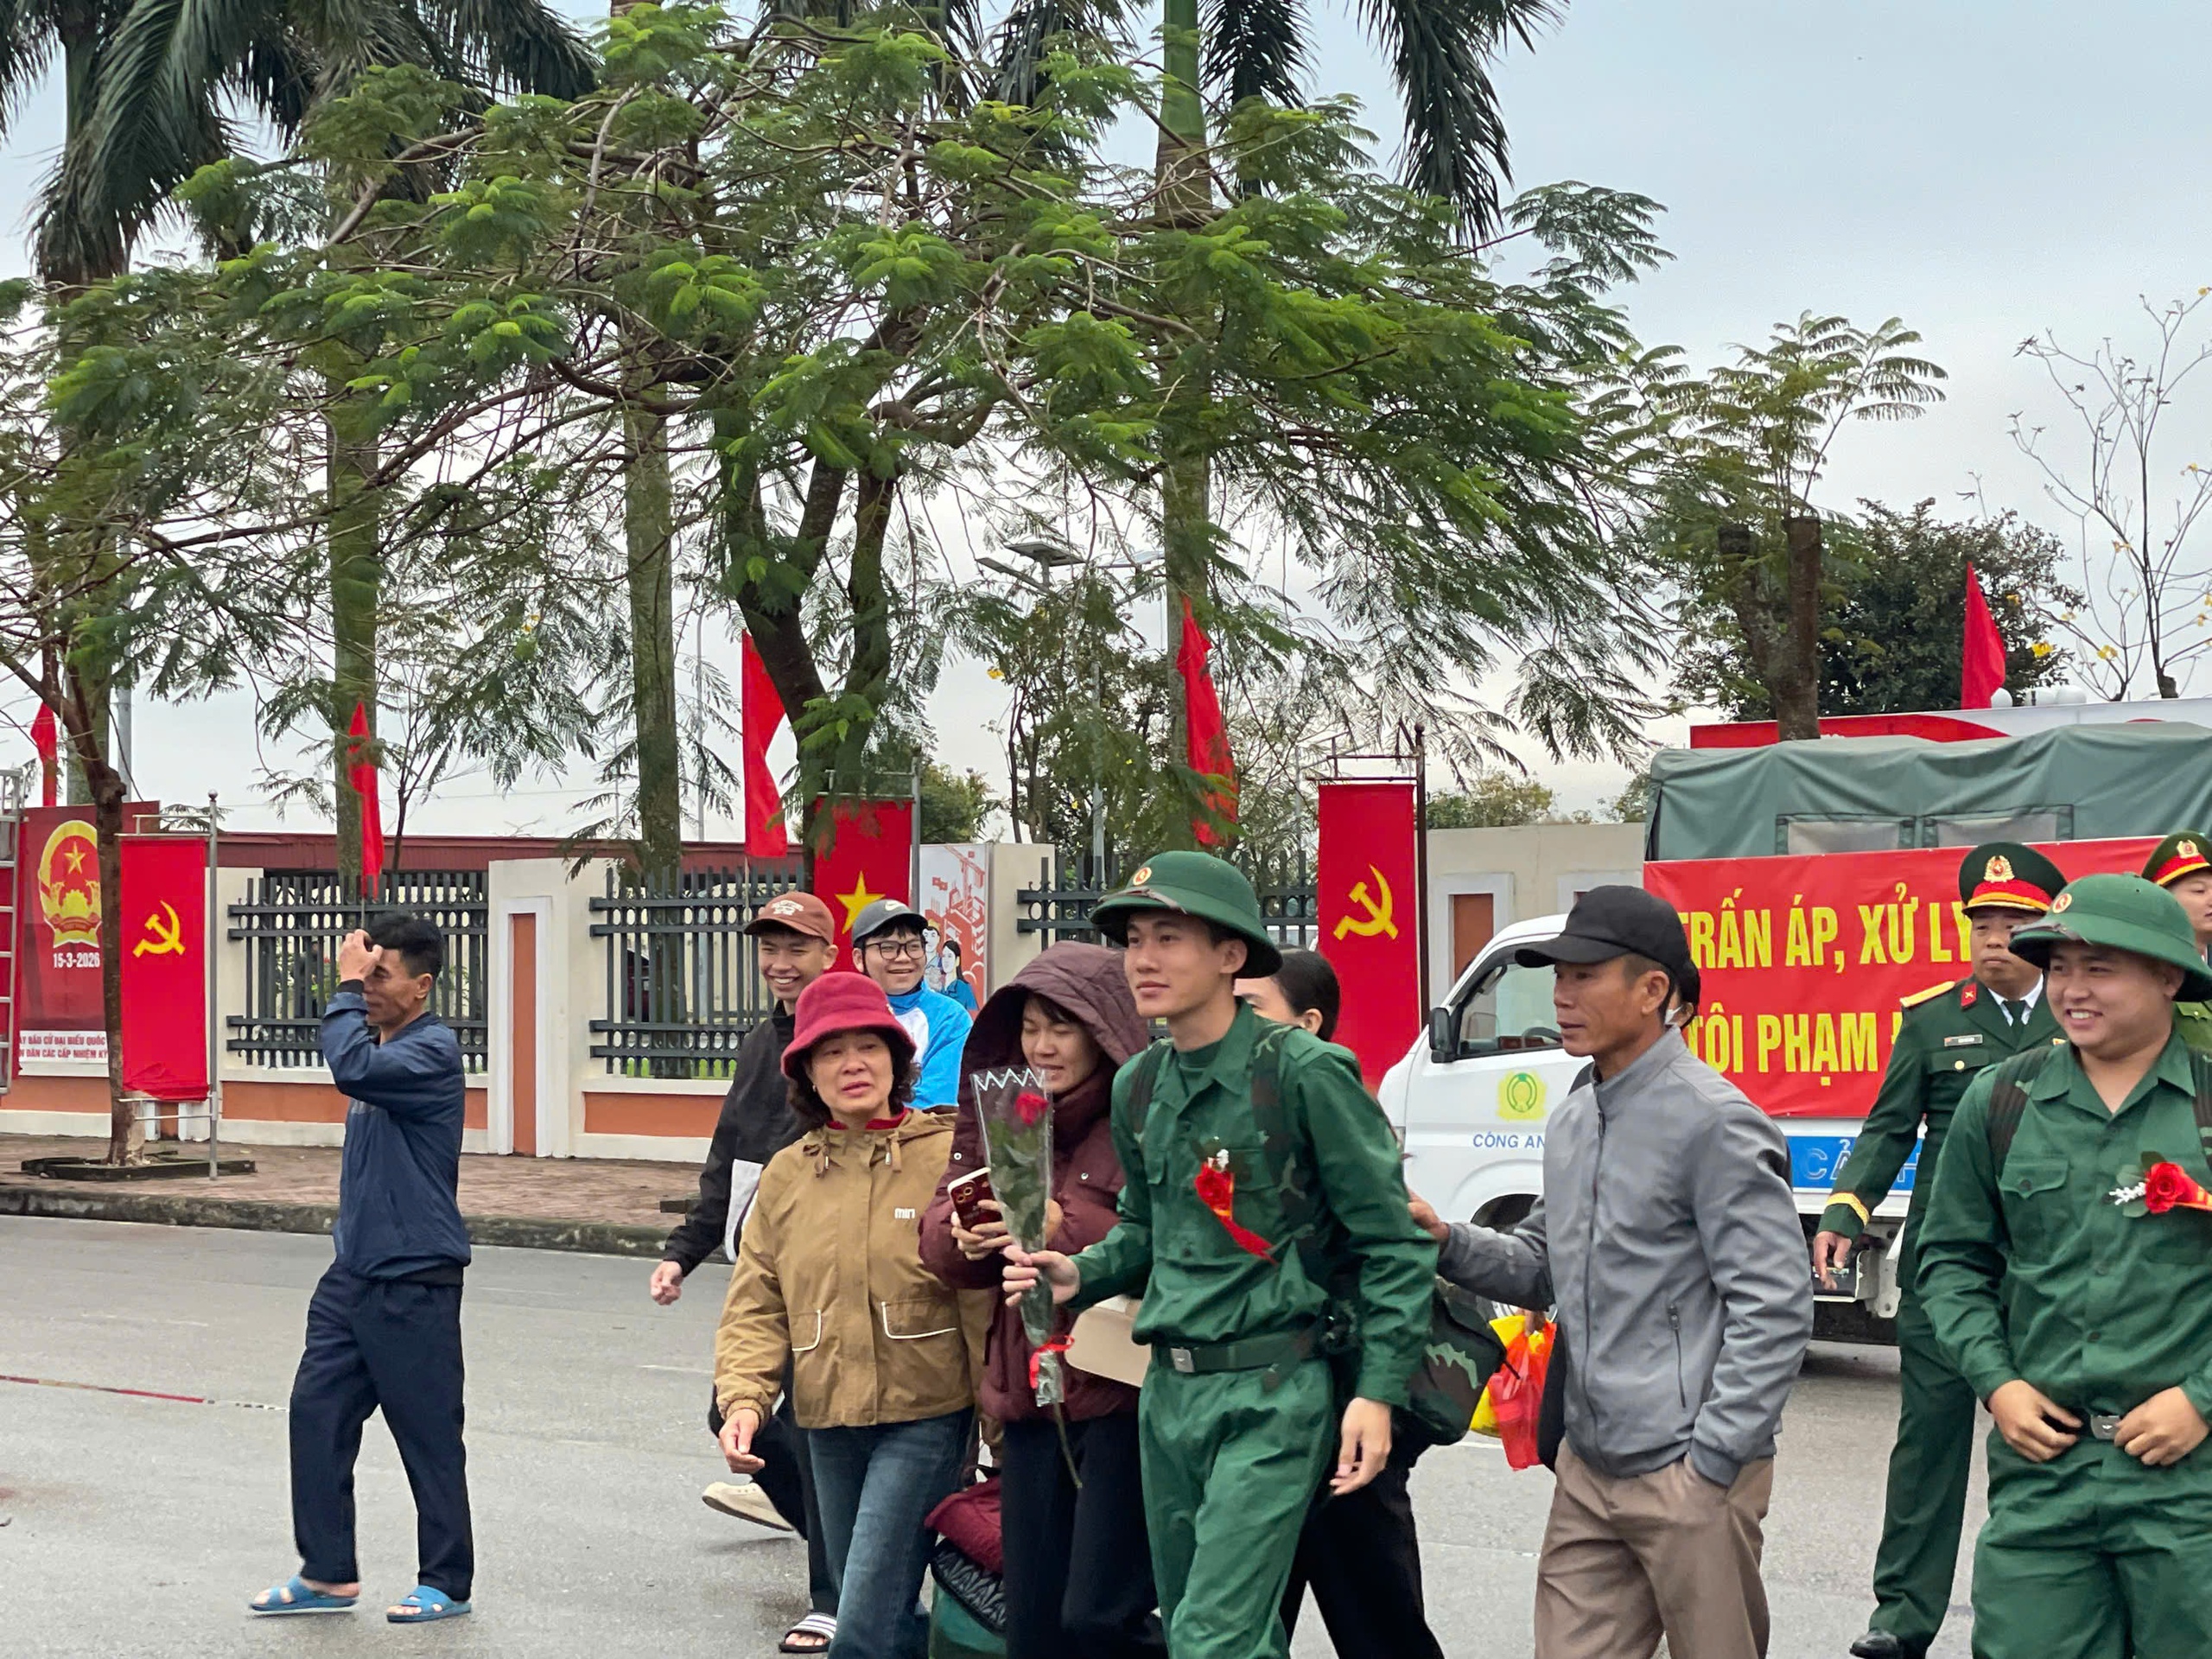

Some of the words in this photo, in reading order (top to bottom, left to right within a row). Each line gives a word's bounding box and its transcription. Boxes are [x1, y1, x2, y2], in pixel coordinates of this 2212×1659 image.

[53, 952, 100, 968] 15-3-2026
[1677, 887, 1772, 969] TRẤN
[1785, 893, 1845, 974] ÁP,
[1858, 881, 1919, 964] XỬ
[1757, 1011, 1878, 1086] PHẠM
